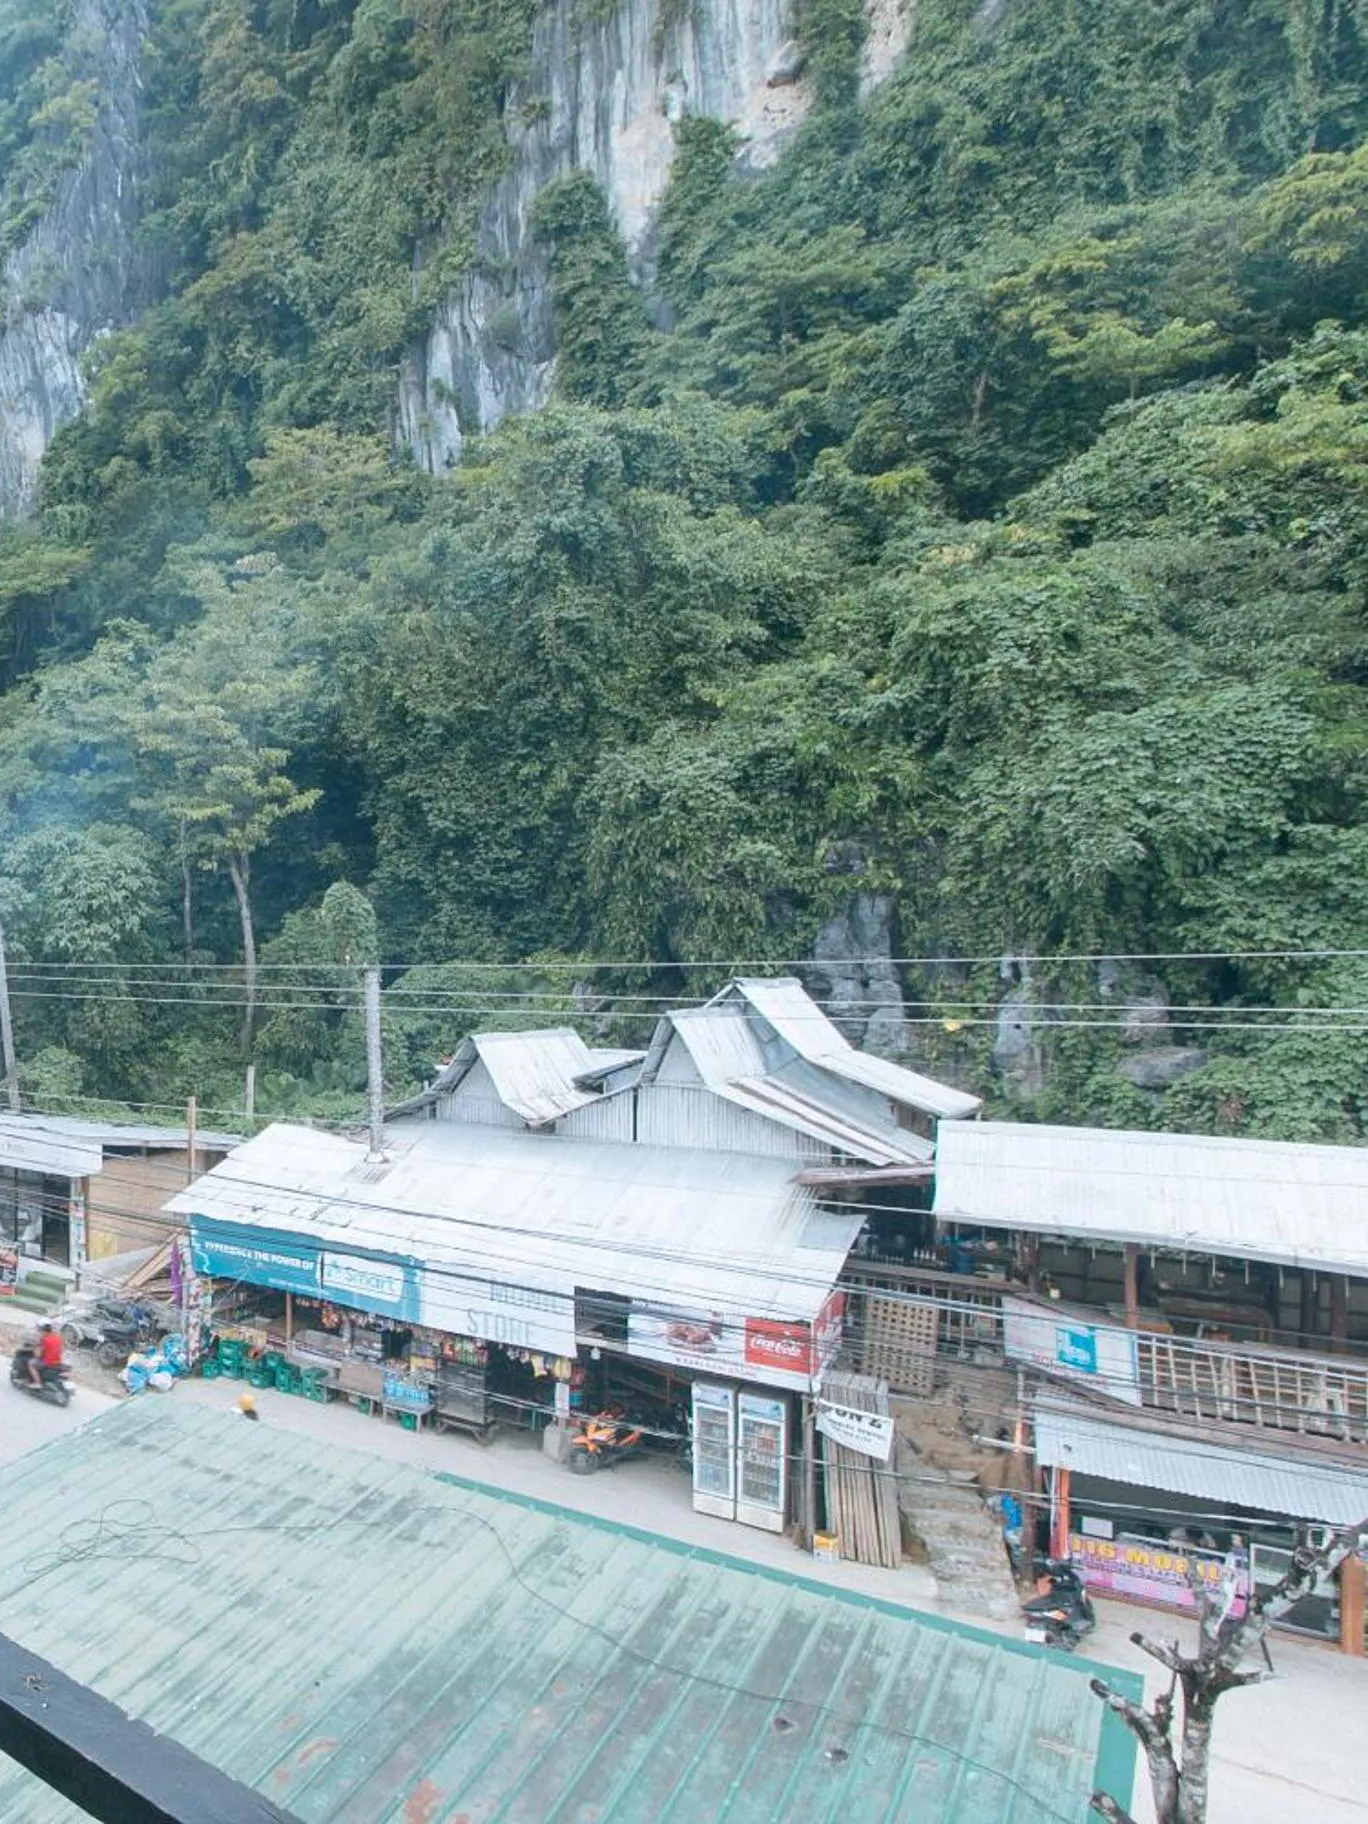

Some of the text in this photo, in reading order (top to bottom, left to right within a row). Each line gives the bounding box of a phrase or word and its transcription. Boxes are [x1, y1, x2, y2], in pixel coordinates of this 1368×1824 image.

[254, 1250, 272, 1262] THE
[271, 1254, 302, 1269] POWER
[301, 1260, 314, 1271] OF
